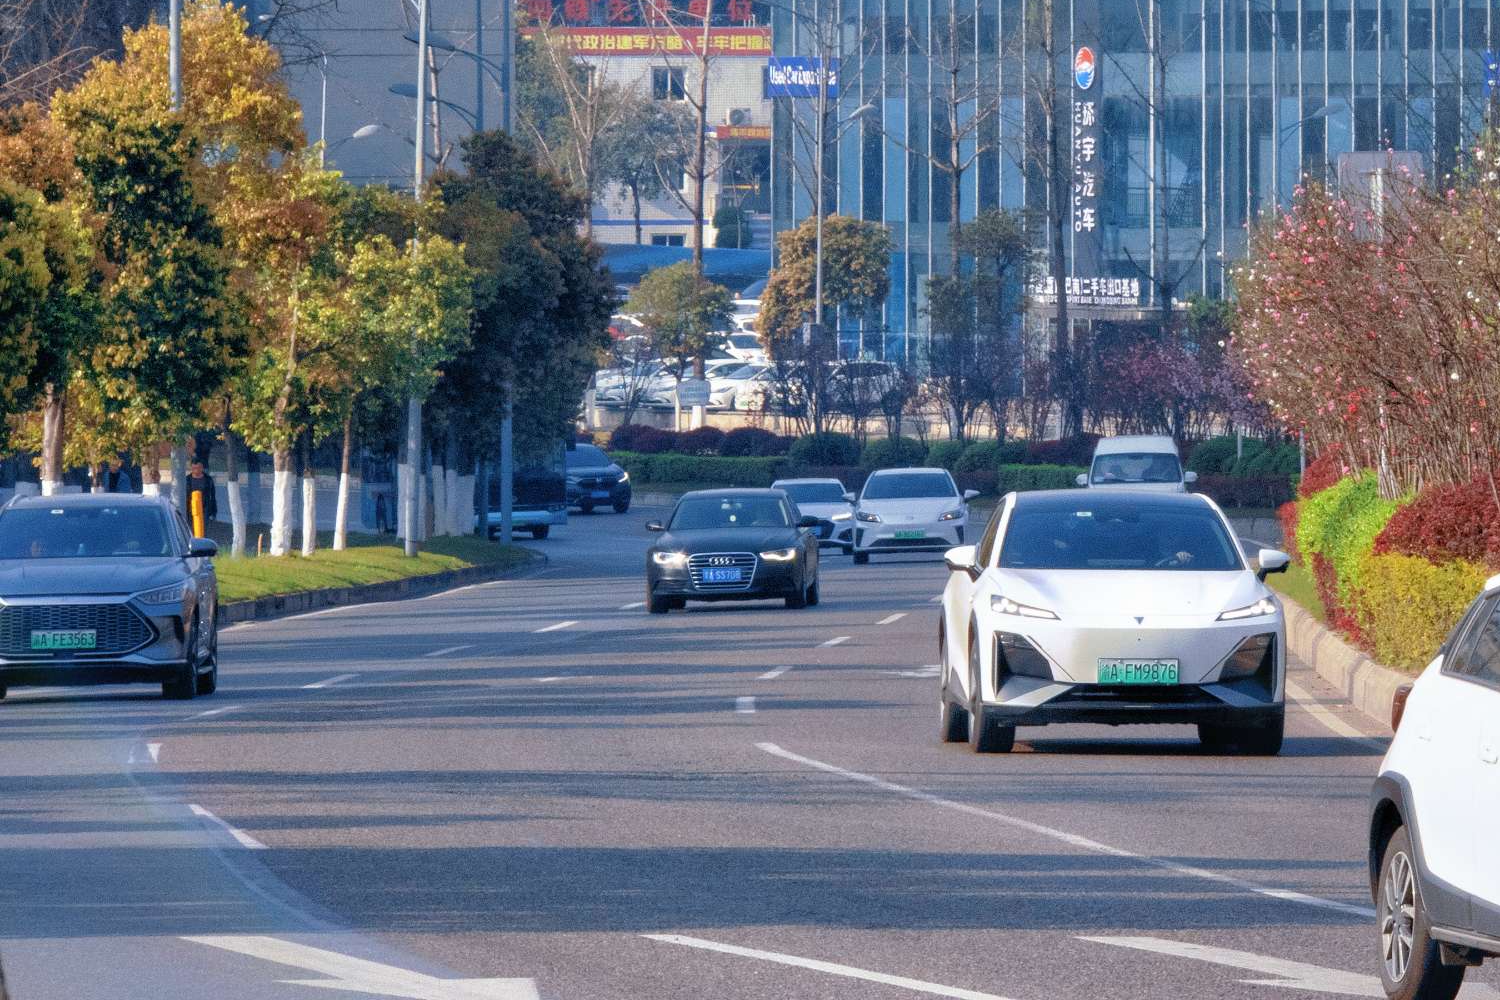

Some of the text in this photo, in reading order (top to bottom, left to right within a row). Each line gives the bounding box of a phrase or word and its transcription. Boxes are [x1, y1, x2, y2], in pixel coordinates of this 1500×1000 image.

[1074, 184, 1082, 233] AUTO
[1082, 101, 1096, 233] 环宇汽车
